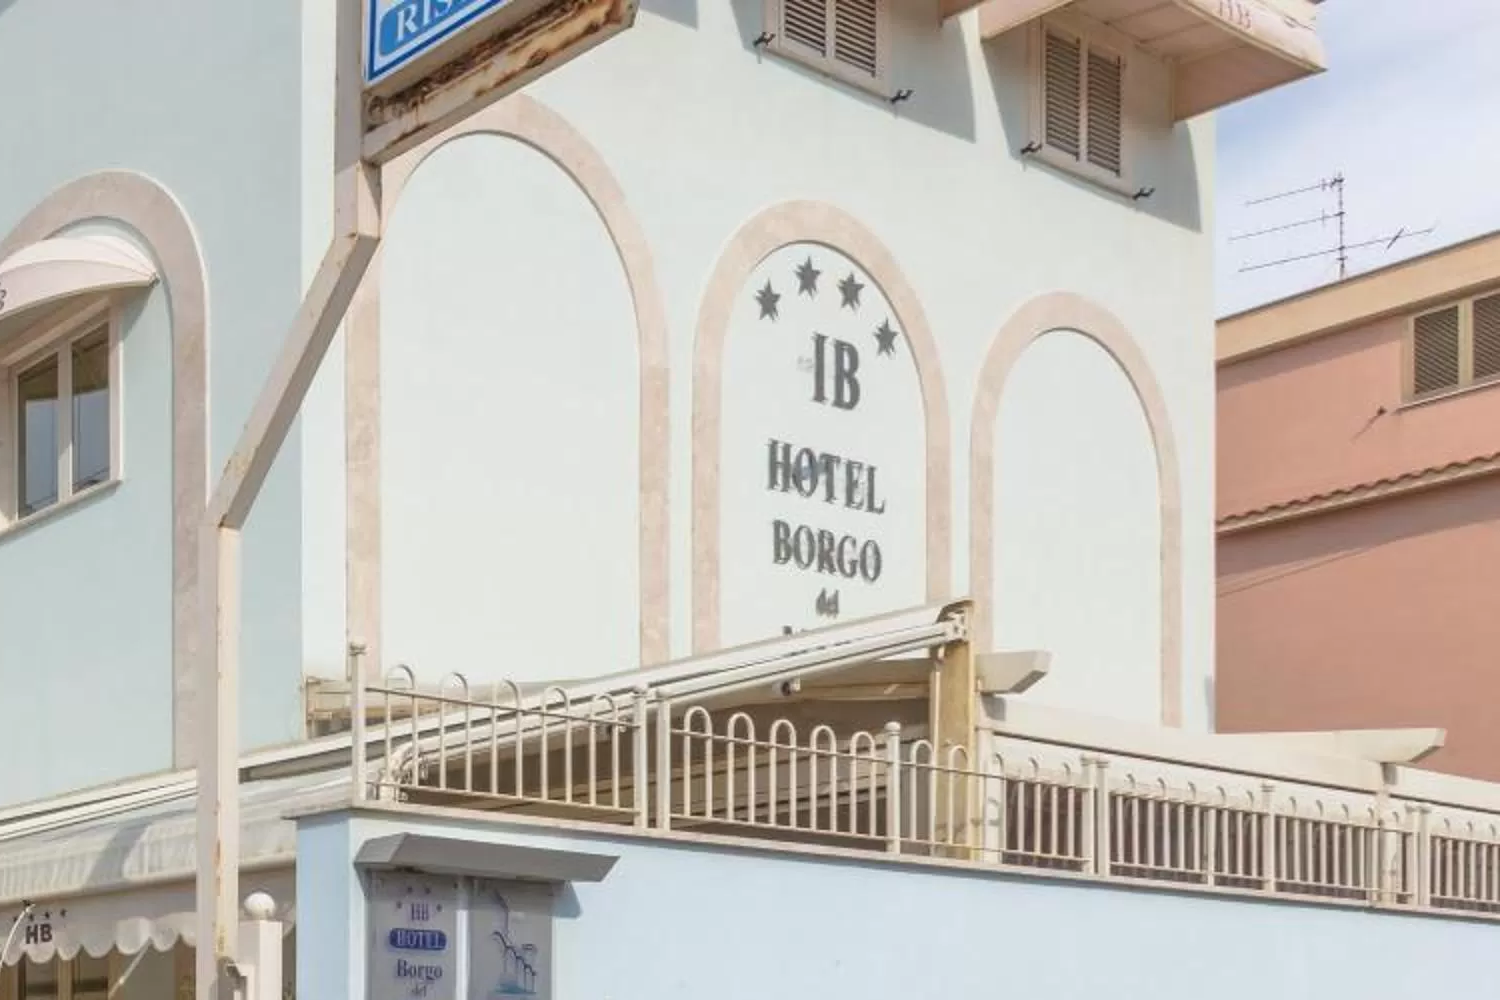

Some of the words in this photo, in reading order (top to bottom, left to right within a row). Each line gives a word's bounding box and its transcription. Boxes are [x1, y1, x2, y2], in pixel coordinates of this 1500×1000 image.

[766, 438, 886, 515] HOTEL
[772, 519, 882, 583] BORGO
[25, 923, 53, 944] HB
[396, 930, 444, 949] HOTEL
[396, 959, 444, 982] Borgo
